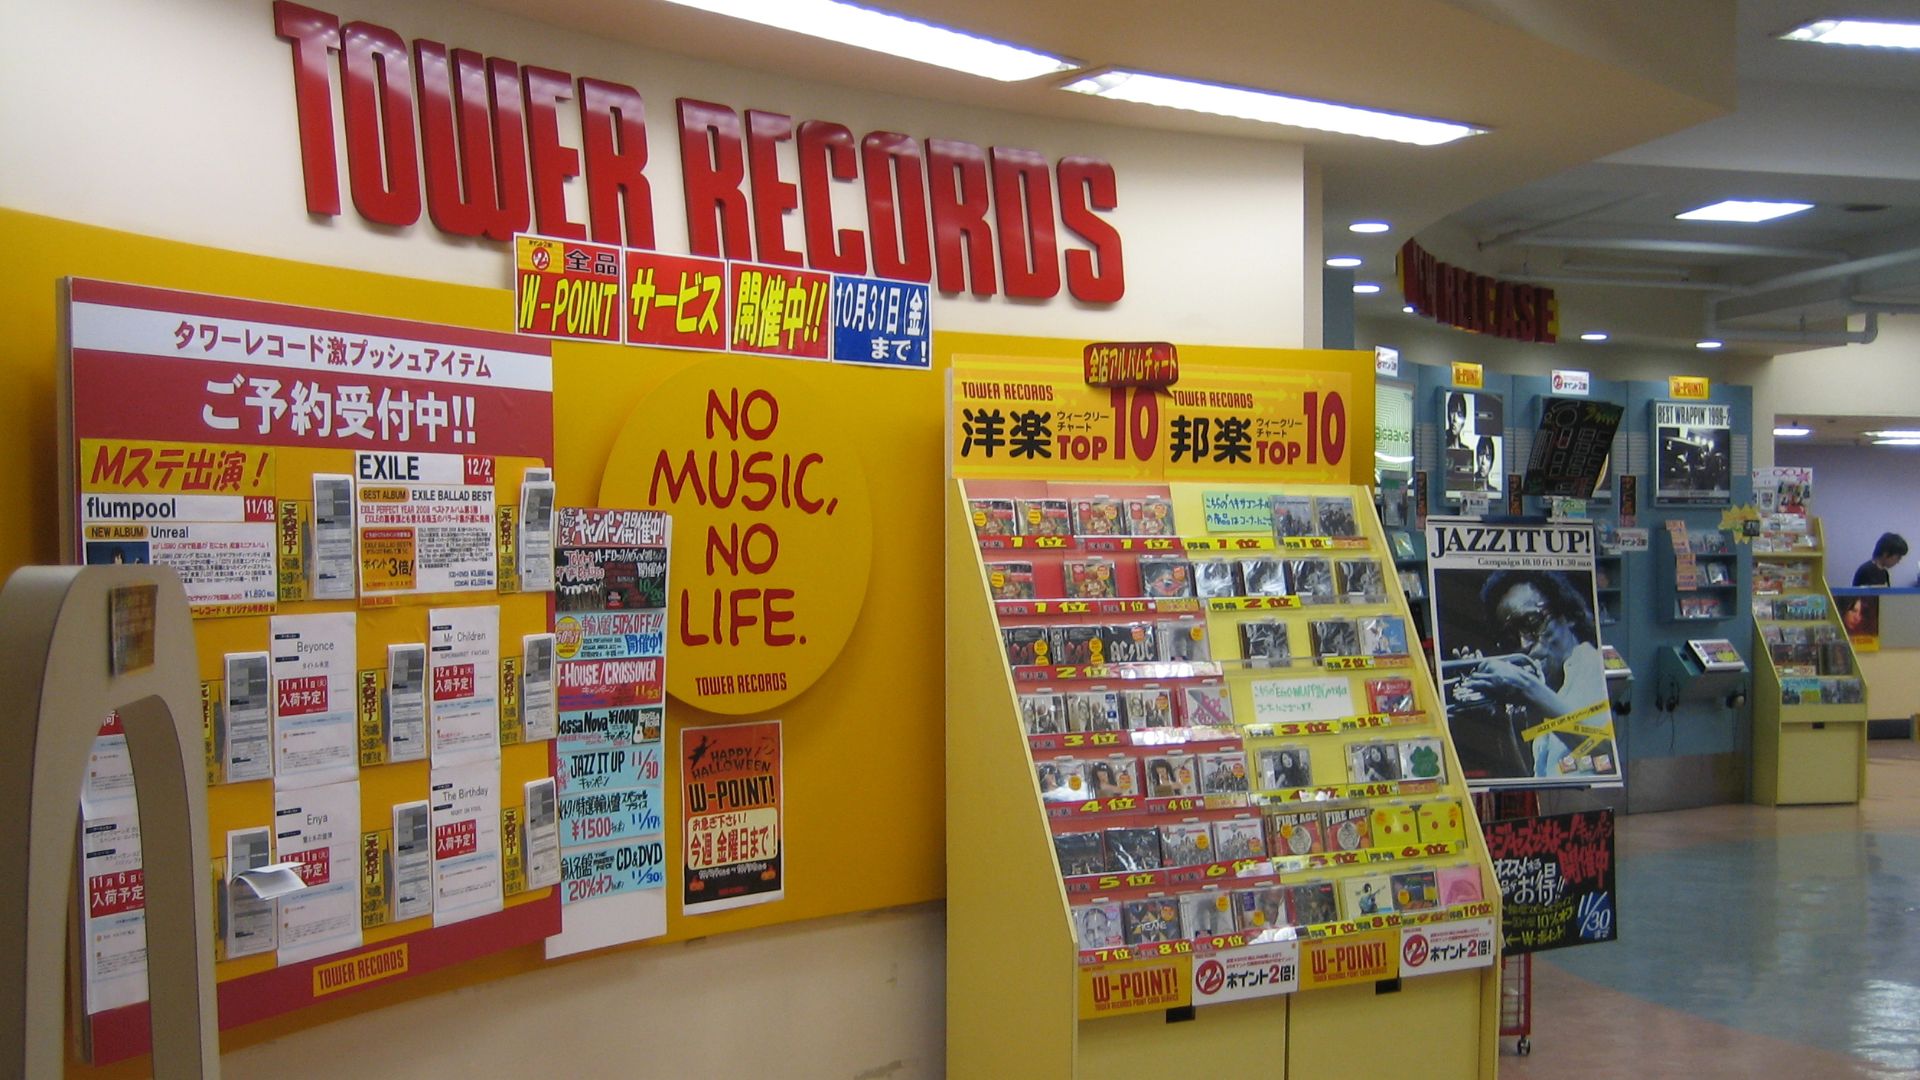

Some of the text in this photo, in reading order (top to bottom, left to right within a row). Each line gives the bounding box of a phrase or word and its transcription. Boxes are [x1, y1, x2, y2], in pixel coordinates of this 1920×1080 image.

[275, 1, 1125, 304] TOWER RECORDS
[565, 249, 618, 276] 全品
[631, 269, 722, 336] サービス
[734, 271, 828, 351] 開催中!!
[835, 282, 928, 338] 10月31日(金)
[173, 319, 493, 380] タワーレコード激プッシュアイテム
[871, 338, 927, 363] まで!
[1088, 346, 1178, 385] 全店アルバムチャート
[962, 381, 1054, 402] TOWER RECORDS
[1173, 390, 1254, 409] TOWER RECORDS
[201, 373, 478, 445] ご予約受付中!!
[705, 387, 779, 441] NO
[1057, 411, 1110, 422] ウィークリー
[1658, 404, 1674, 425] BEST
[961, 408, 1054, 460] 洋楽
[1057, 386, 1159, 462] TOP 10
[1057, 421, 1093, 433] チャート
[1256, 418, 1303, 429] ウィークリー
[1256, 391, 1346, 465] TOP 10
[1256, 428, 1288, 439] チャート
[1170, 414, 1252, 465] 邦楽
[90, 445, 269, 492] Mステ出演!
[360, 454, 491, 480] EXILE 12/2
[363, 489, 407, 499] BEST ALBUM
[412, 489, 493, 501] EXILE BALLAD BEST
[648, 449, 839, 516] MUSIC,
[87, 497, 275, 520] flumpool 11/18
[91, 527, 144, 538] NEW ALBUM
[151, 526, 189, 539] Unreal
[1431, 527, 1591, 558] JAZZ IT UP!
[705, 522, 779, 576] NO
[363, 559, 388, 571] ポイント
[389, 558, 414, 578] 3倍!
[1477, 557, 1521, 568] Campaign
[680, 588, 807, 647] LIFE.
[296, 641, 335, 654] Beyonce
[456, 631, 487, 642] Children
[435, 677, 473, 694] 入荷予定!
[695, 672, 788, 696] TOWER RECORDS
[280, 692, 327, 709] 入荷予定!
[570, 753, 594, 778] JAZZ
[597, 752, 610, 774] IT
[611, 750, 625, 774] UP
[711, 746, 752, 762] HAPPY
[692, 758, 771, 780] HALLOWEEN
[443, 786, 489, 801] The Birthday
[688, 776, 776, 813] W-POINT!
[306, 813, 329, 826] Enya
[571, 816, 612, 841] ¥1500
[692, 812, 747, 832] お急ぎ下さい!
[1325, 810, 1348, 826] FIRE
[437, 834, 475, 851] 入荷予定!
[690, 824, 776, 867] 今週 金曜日まで!
[616, 842, 663, 872] CD&DVD
[568, 873, 612, 902] 20%オフ
[1577, 890, 1611, 938] 11/30
[1311, 942, 1387, 975] W-POINT!
[1429, 939, 1492, 962] ポイント2倍!
[318, 948, 405, 990] TOWER RECORDS
[1226, 964, 1295, 990] ポイント2倍!
[1092, 967, 1178, 1003] W-POINT!
